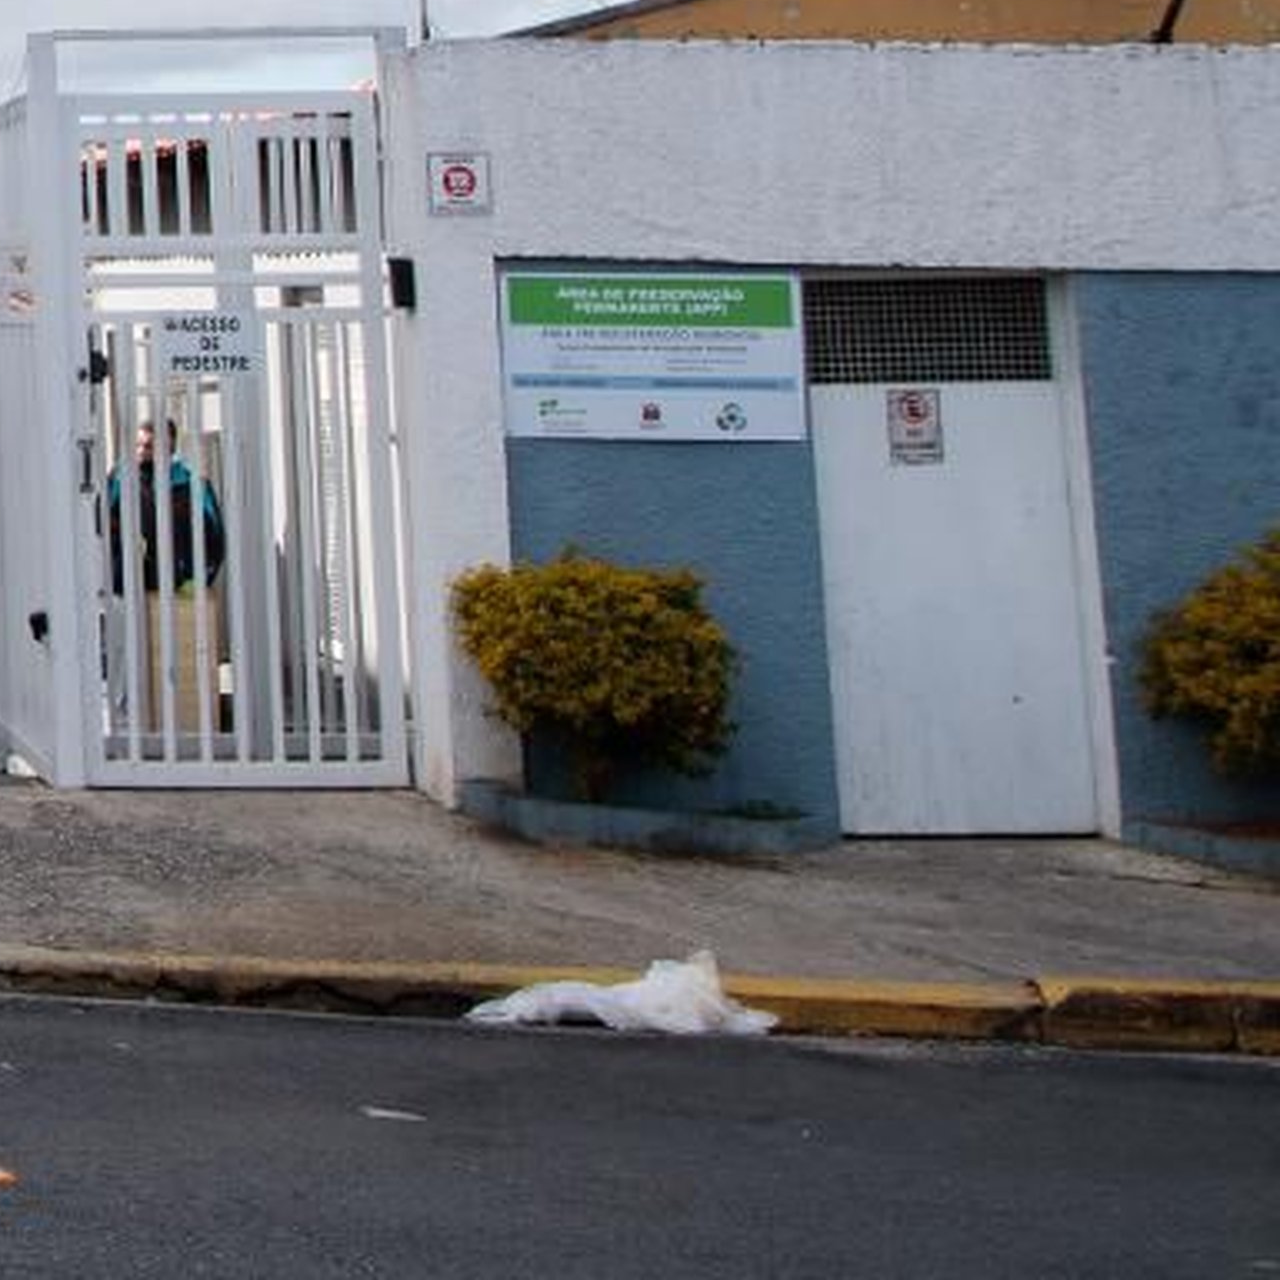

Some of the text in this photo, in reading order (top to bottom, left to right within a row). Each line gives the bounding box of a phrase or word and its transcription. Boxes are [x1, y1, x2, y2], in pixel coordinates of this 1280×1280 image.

[181, 316, 241, 333] ACESSO
[200, 335, 220, 351] DE
[171, 355, 251, 372] PEDESTRE
